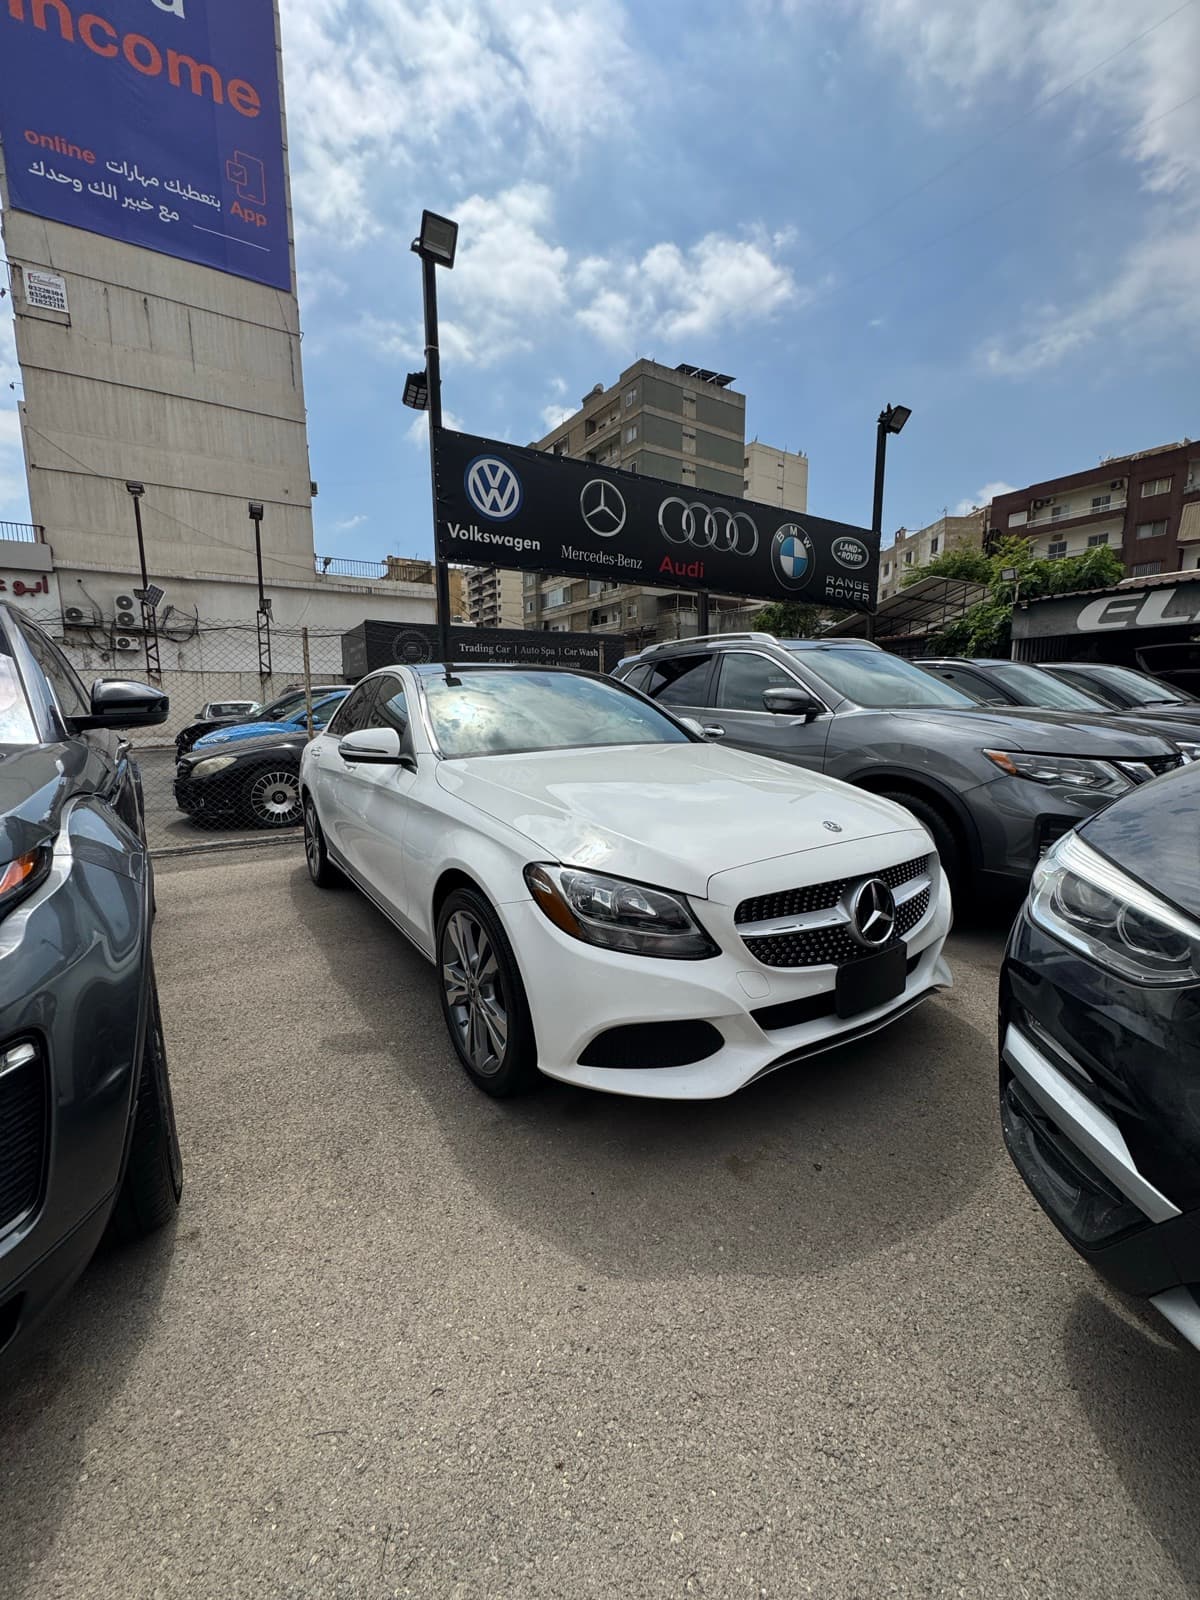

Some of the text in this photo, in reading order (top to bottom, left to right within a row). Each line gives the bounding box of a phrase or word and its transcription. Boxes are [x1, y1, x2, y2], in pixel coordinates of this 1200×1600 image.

[24, 129, 221, 212] بتعطيك مهارات online
[28, 160, 83, 192] وحدك
[122, 197, 154, 212] خبير
[158, 205, 180, 222] مع
[230, 201, 267, 228] App
[447, 522, 541, 552] Volkswagen
[776, 525, 812, 549] BMW
[839, 542, 858, 553] LAND
[560, 544, 643, 570] Mercedes-Benz
[659, 555, 705, 578] Audi
[841, 551, 863, 563] ROVER
[825, 575, 870, 592] RANGE
[825, 587, 870, 602] ROVER
[1077, 588, 1200, 631] EL
[459, 643, 599, 657] Trading Car Auto Spa Car Wash
